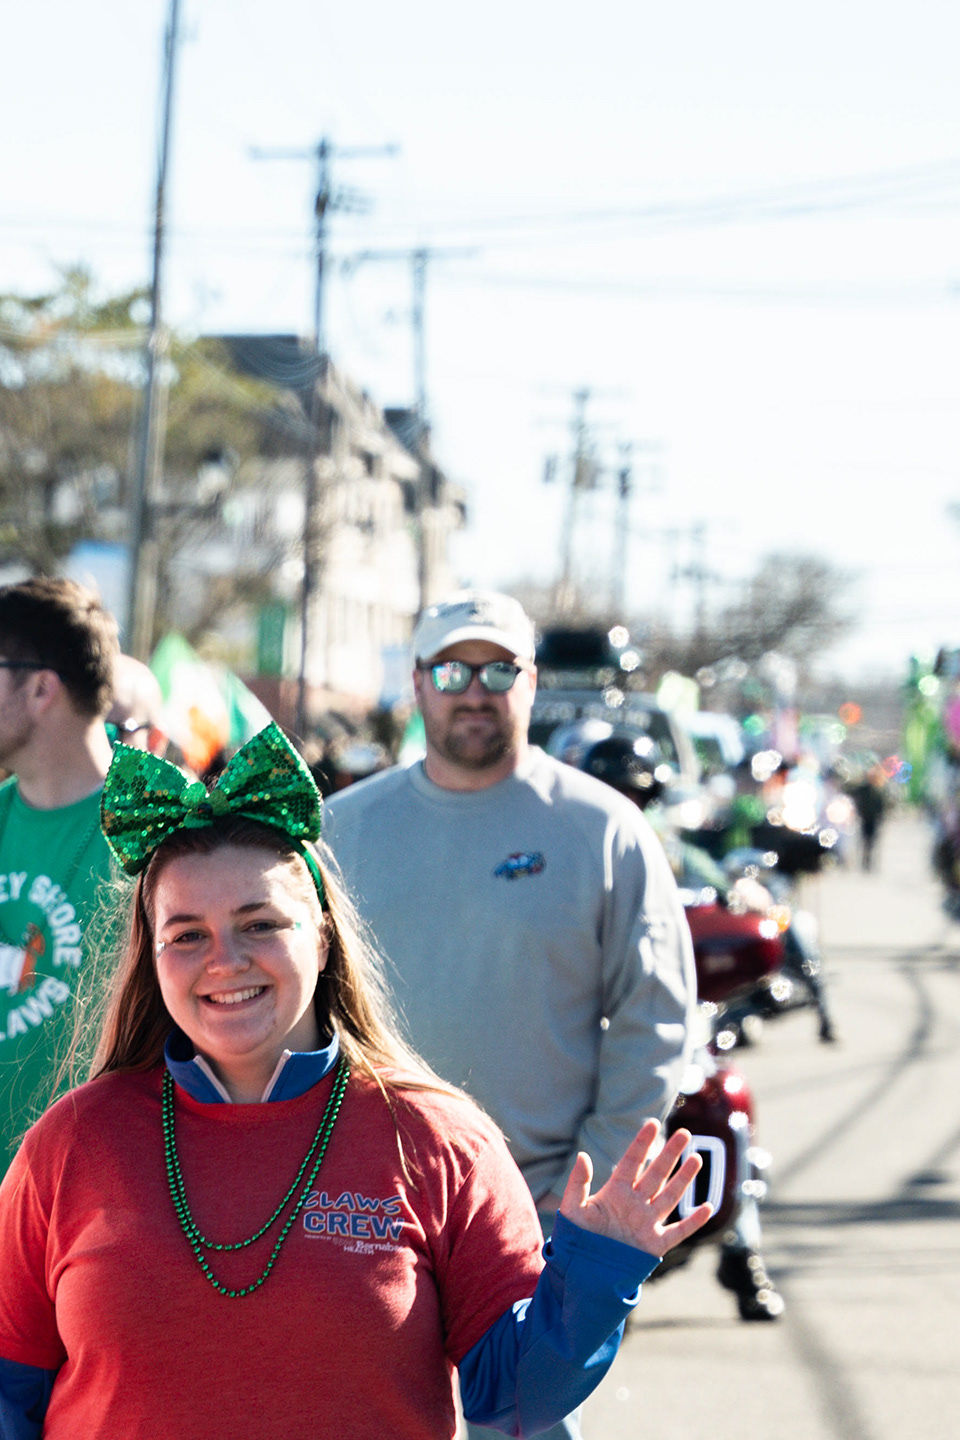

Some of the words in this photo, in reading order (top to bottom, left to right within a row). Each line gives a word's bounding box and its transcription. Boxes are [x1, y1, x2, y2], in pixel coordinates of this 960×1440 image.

[28, 874, 83, 968] SHORE
[303, 1190, 403, 1214] CLAWS
[303, 1211, 404, 1240] CREW
[355, 1240, 403, 1252] Barnaba
